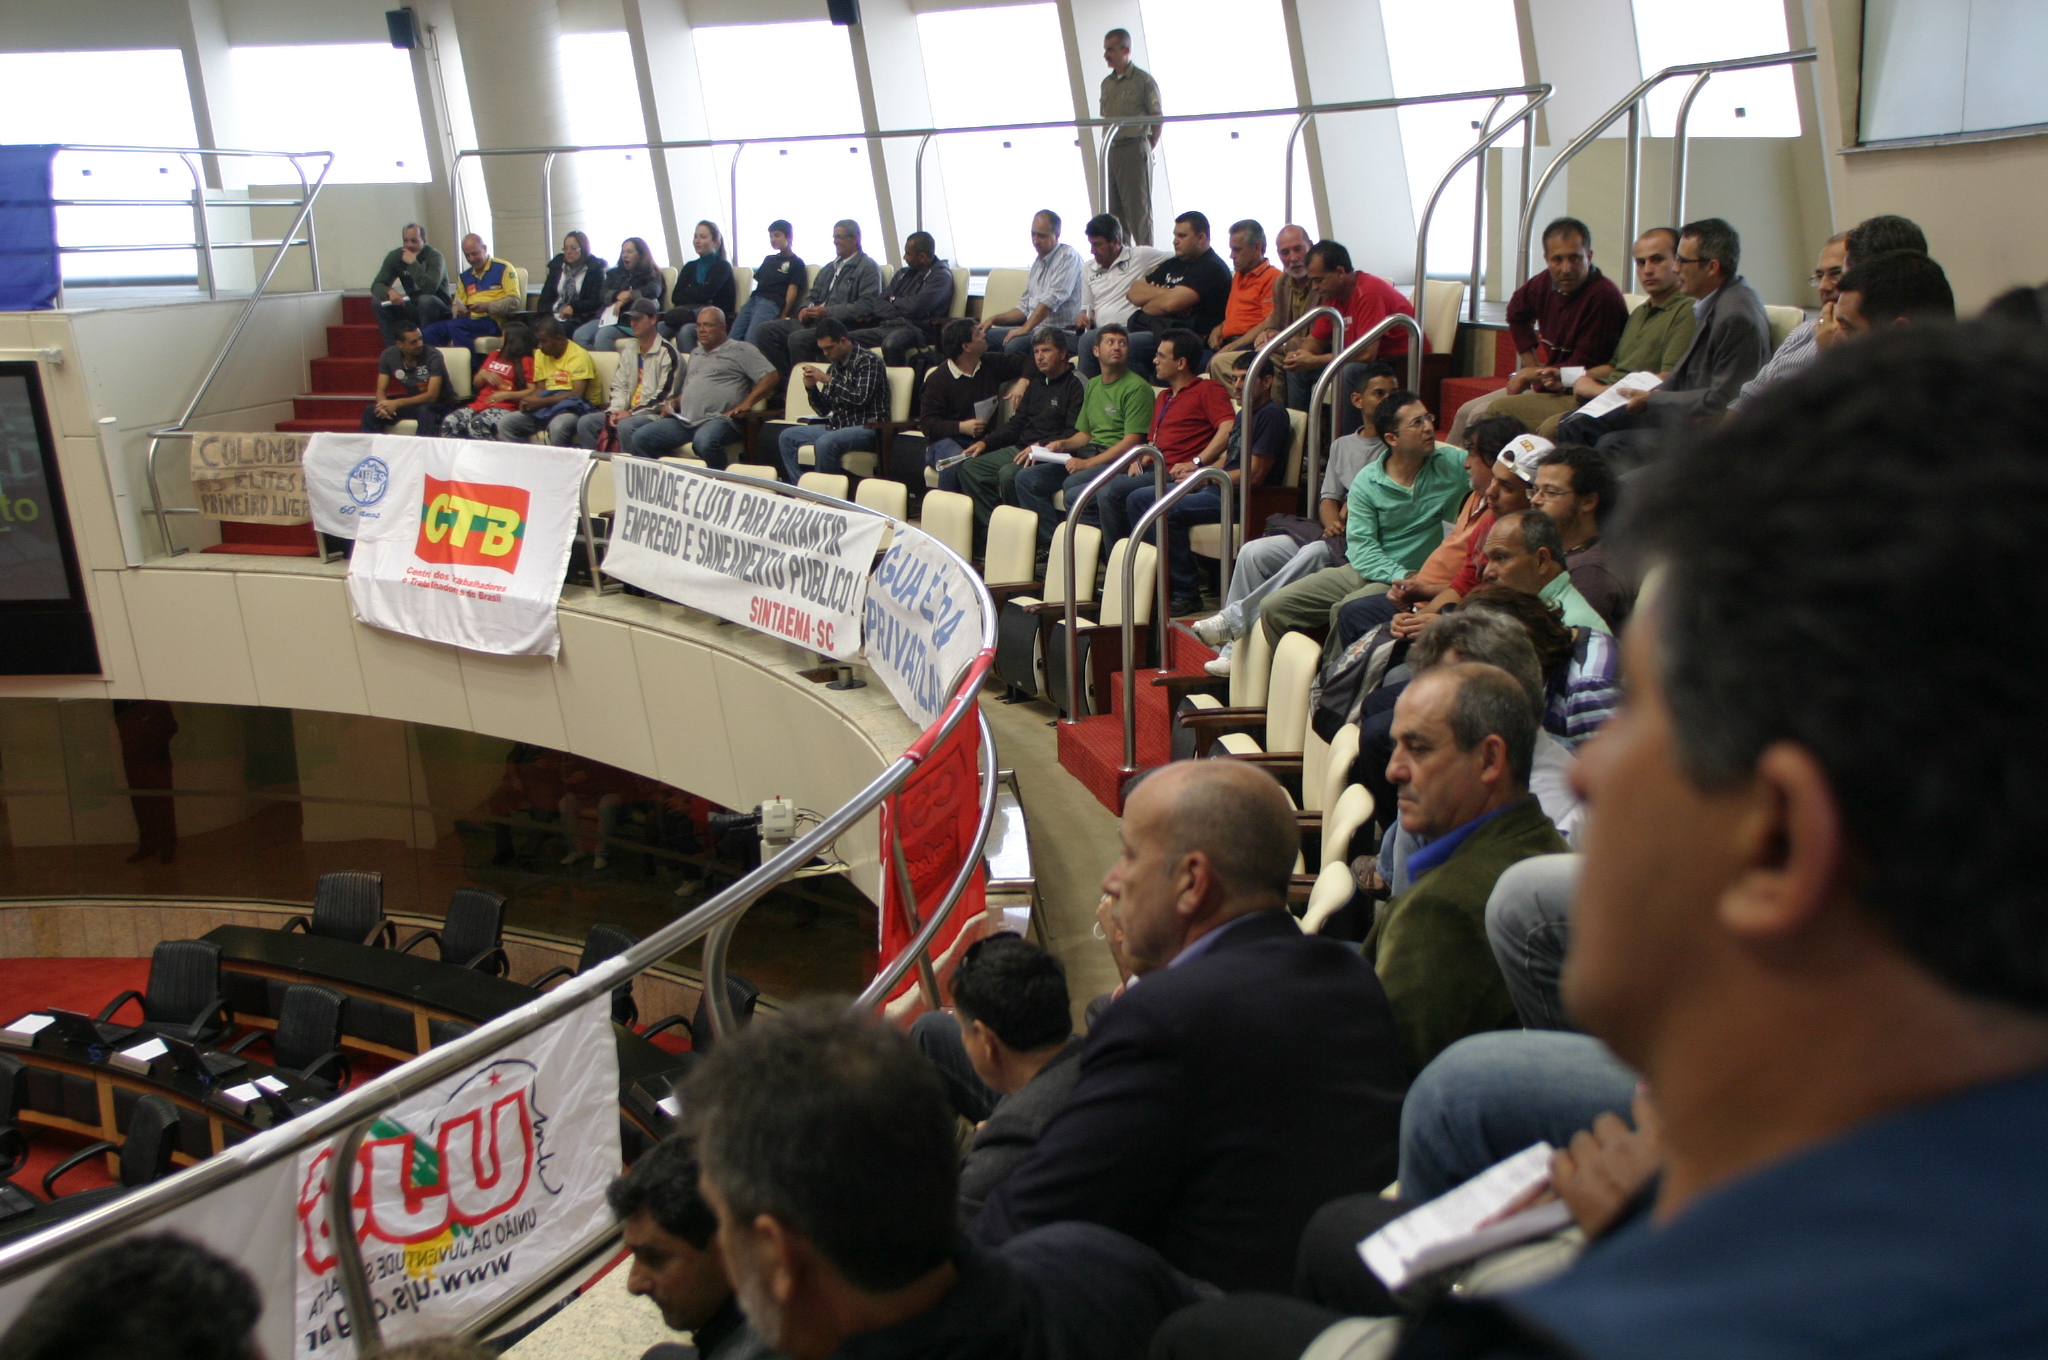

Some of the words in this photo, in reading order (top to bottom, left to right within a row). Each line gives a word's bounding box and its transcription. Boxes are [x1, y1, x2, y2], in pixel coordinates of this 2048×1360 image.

[415, 365, 428, 376] 35
[234, 469, 297, 493] ELITES
[356, 470, 386, 484] UBES
[339, 504, 356, 515] 60
[625, 463, 685, 512] UNIDADE
[682, 486, 692, 516] E
[693, 485, 735, 527] LUTA
[733, 493, 777, 538] PARA
[769, 504, 848, 557] GARANTIR
[425, 493, 521, 557] CTB
[621, 505, 683, 556] EMPREGO
[682, 527, 695, 562] E
[695, 532, 789, 591] SANEAMENTO
[434, 570, 450, 580] dos
[478, 587, 503, 602] Brasil
